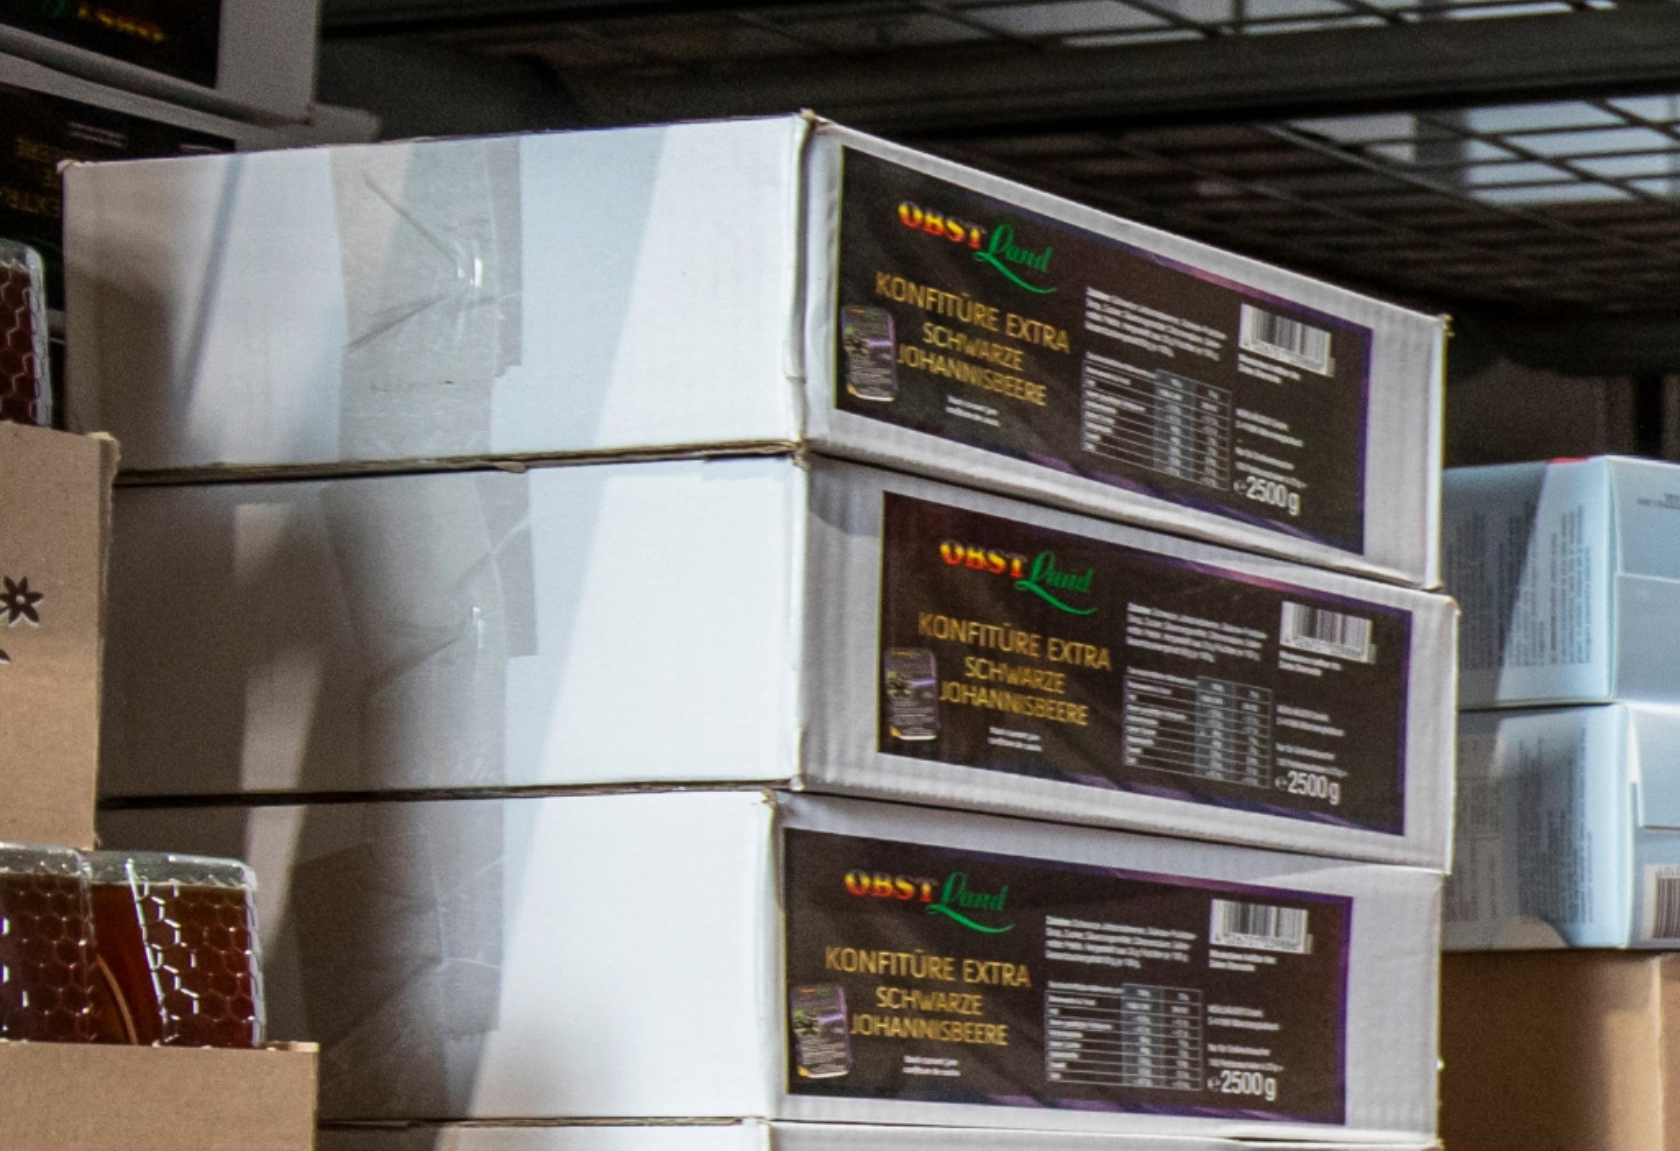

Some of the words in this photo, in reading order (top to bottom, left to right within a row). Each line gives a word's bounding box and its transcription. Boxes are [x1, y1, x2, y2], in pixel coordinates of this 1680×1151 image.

[899, 200, 986, 250] OBST
[876, 271, 1001, 332] KONFITÜRE
[1005, 313, 1071, 354] EXTRA
[923, 321, 1024, 371] SCHWARZE
[898, 343, 1047, 407] JOHANNISBEERE
[940, 540, 1028, 578] OBST
[918, 611, 1041, 658] KONFITÜRE
[1046, 637, 1112, 671] EXTRA
[964, 655, 1066, 695] SCHWARZE
[940, 680, 1089, 726] JOHANNISBEERE
[845, 869, 939, 902] OBST
[824, 945, 956, 982] KONFITÜRE
[963, 959, 1032, 988] EXTRA
[876, 986, 983, 1016] SCHWARZE
[851, 1013, 1009, 1046] JOHANNISBEERE
